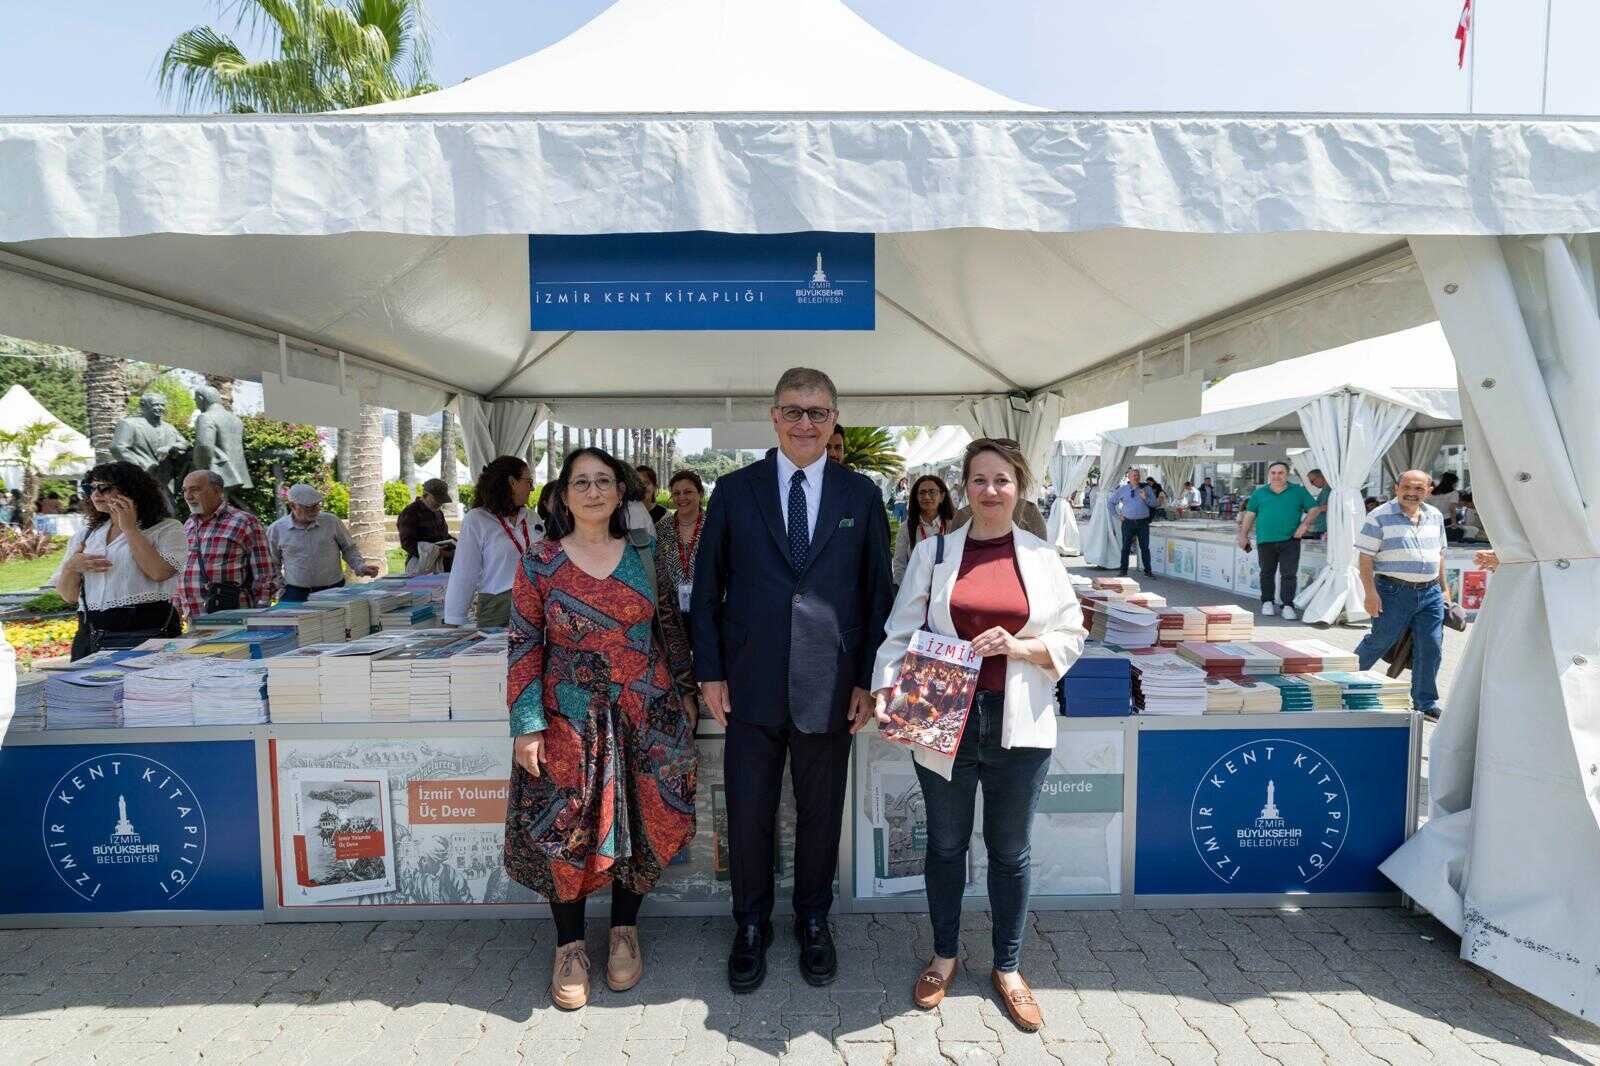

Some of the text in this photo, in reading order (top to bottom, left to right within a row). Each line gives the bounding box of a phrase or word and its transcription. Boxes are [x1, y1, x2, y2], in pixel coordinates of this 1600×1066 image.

[535, 289, 764, 304] İZMİR KENT KİTAPLIĞI
[926, 637, 977, 664] İZMİR
[419, 784, 453, 800] İzmir
[1041, 780, 1093, 796] öylerde
[419, 802, 476, 820] Üç Deve
[1196, 747, 1341, 880] İZMİR KENT KİTAPLIĞI
[50, 762, 198, 897] İZMİR KENT KİTAPLIĞI
